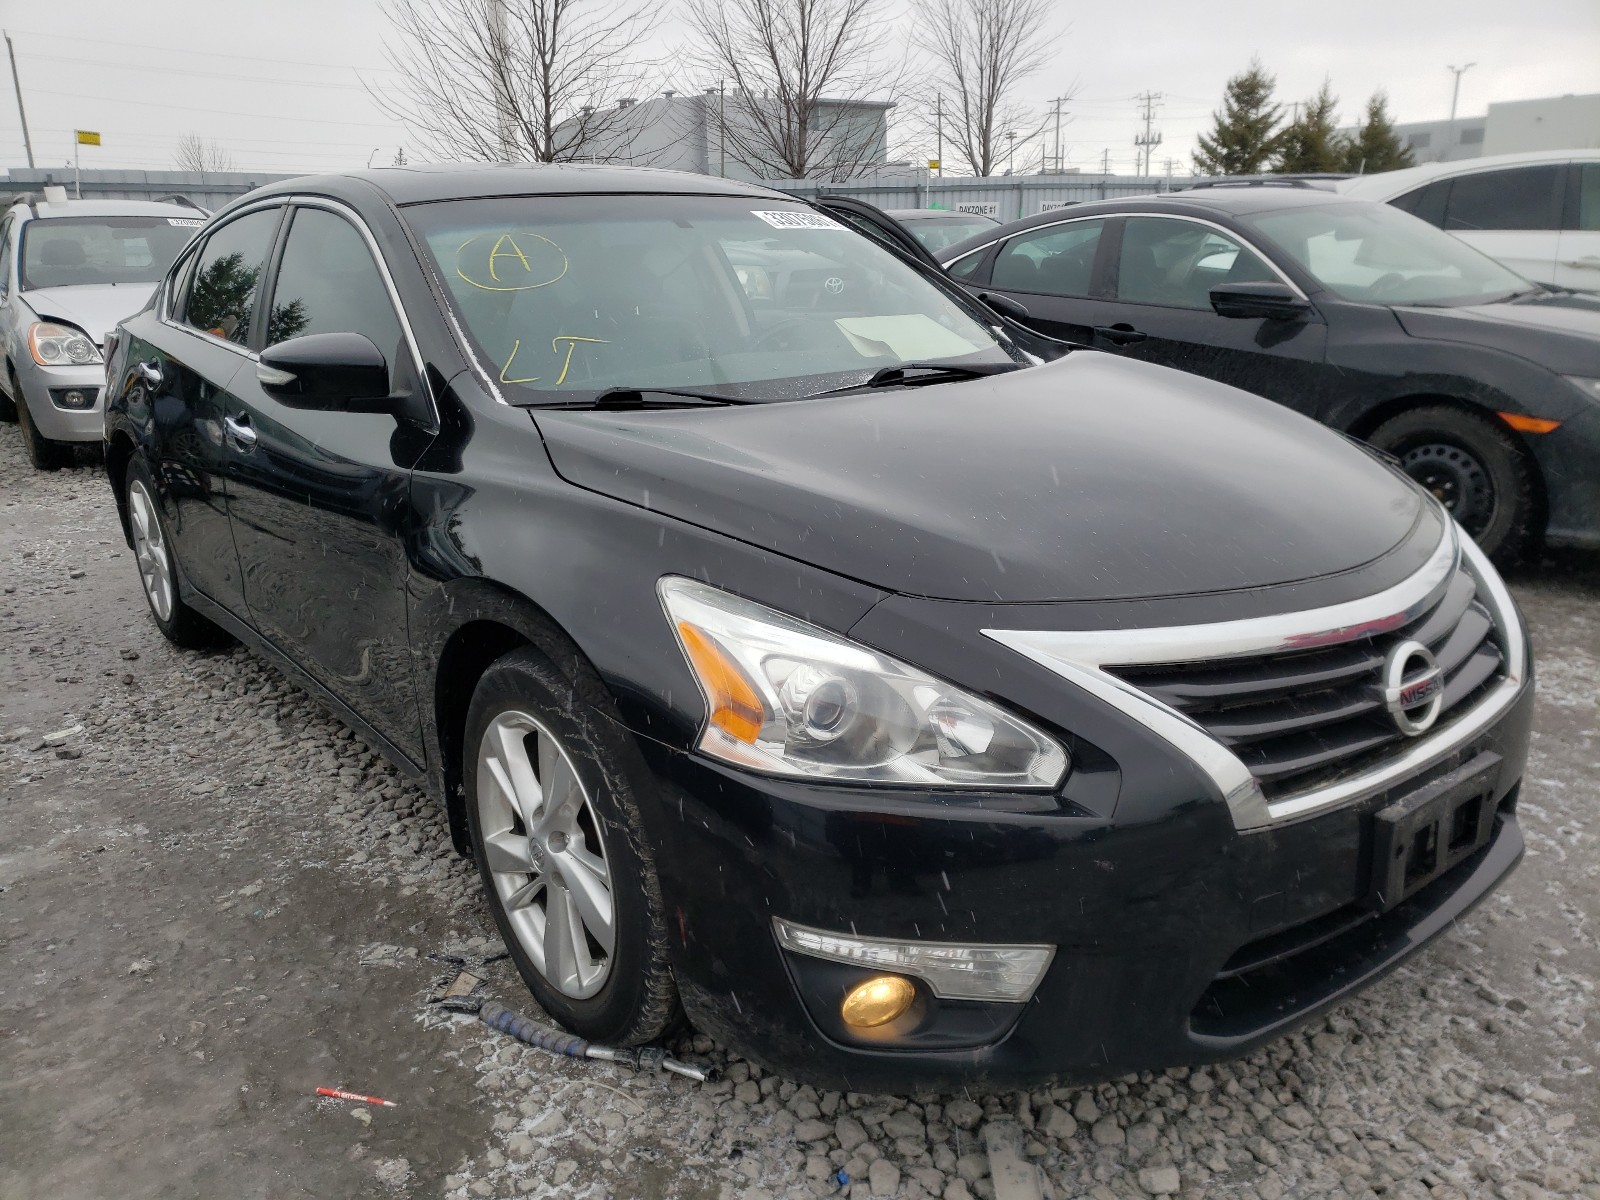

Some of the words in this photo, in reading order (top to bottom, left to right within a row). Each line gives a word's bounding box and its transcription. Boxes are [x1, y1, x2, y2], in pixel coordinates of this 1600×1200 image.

[960, 205, 988, 215] DAYZONE
[989, 205, 996, 214] #1
[489, 234, 532, 282] A
